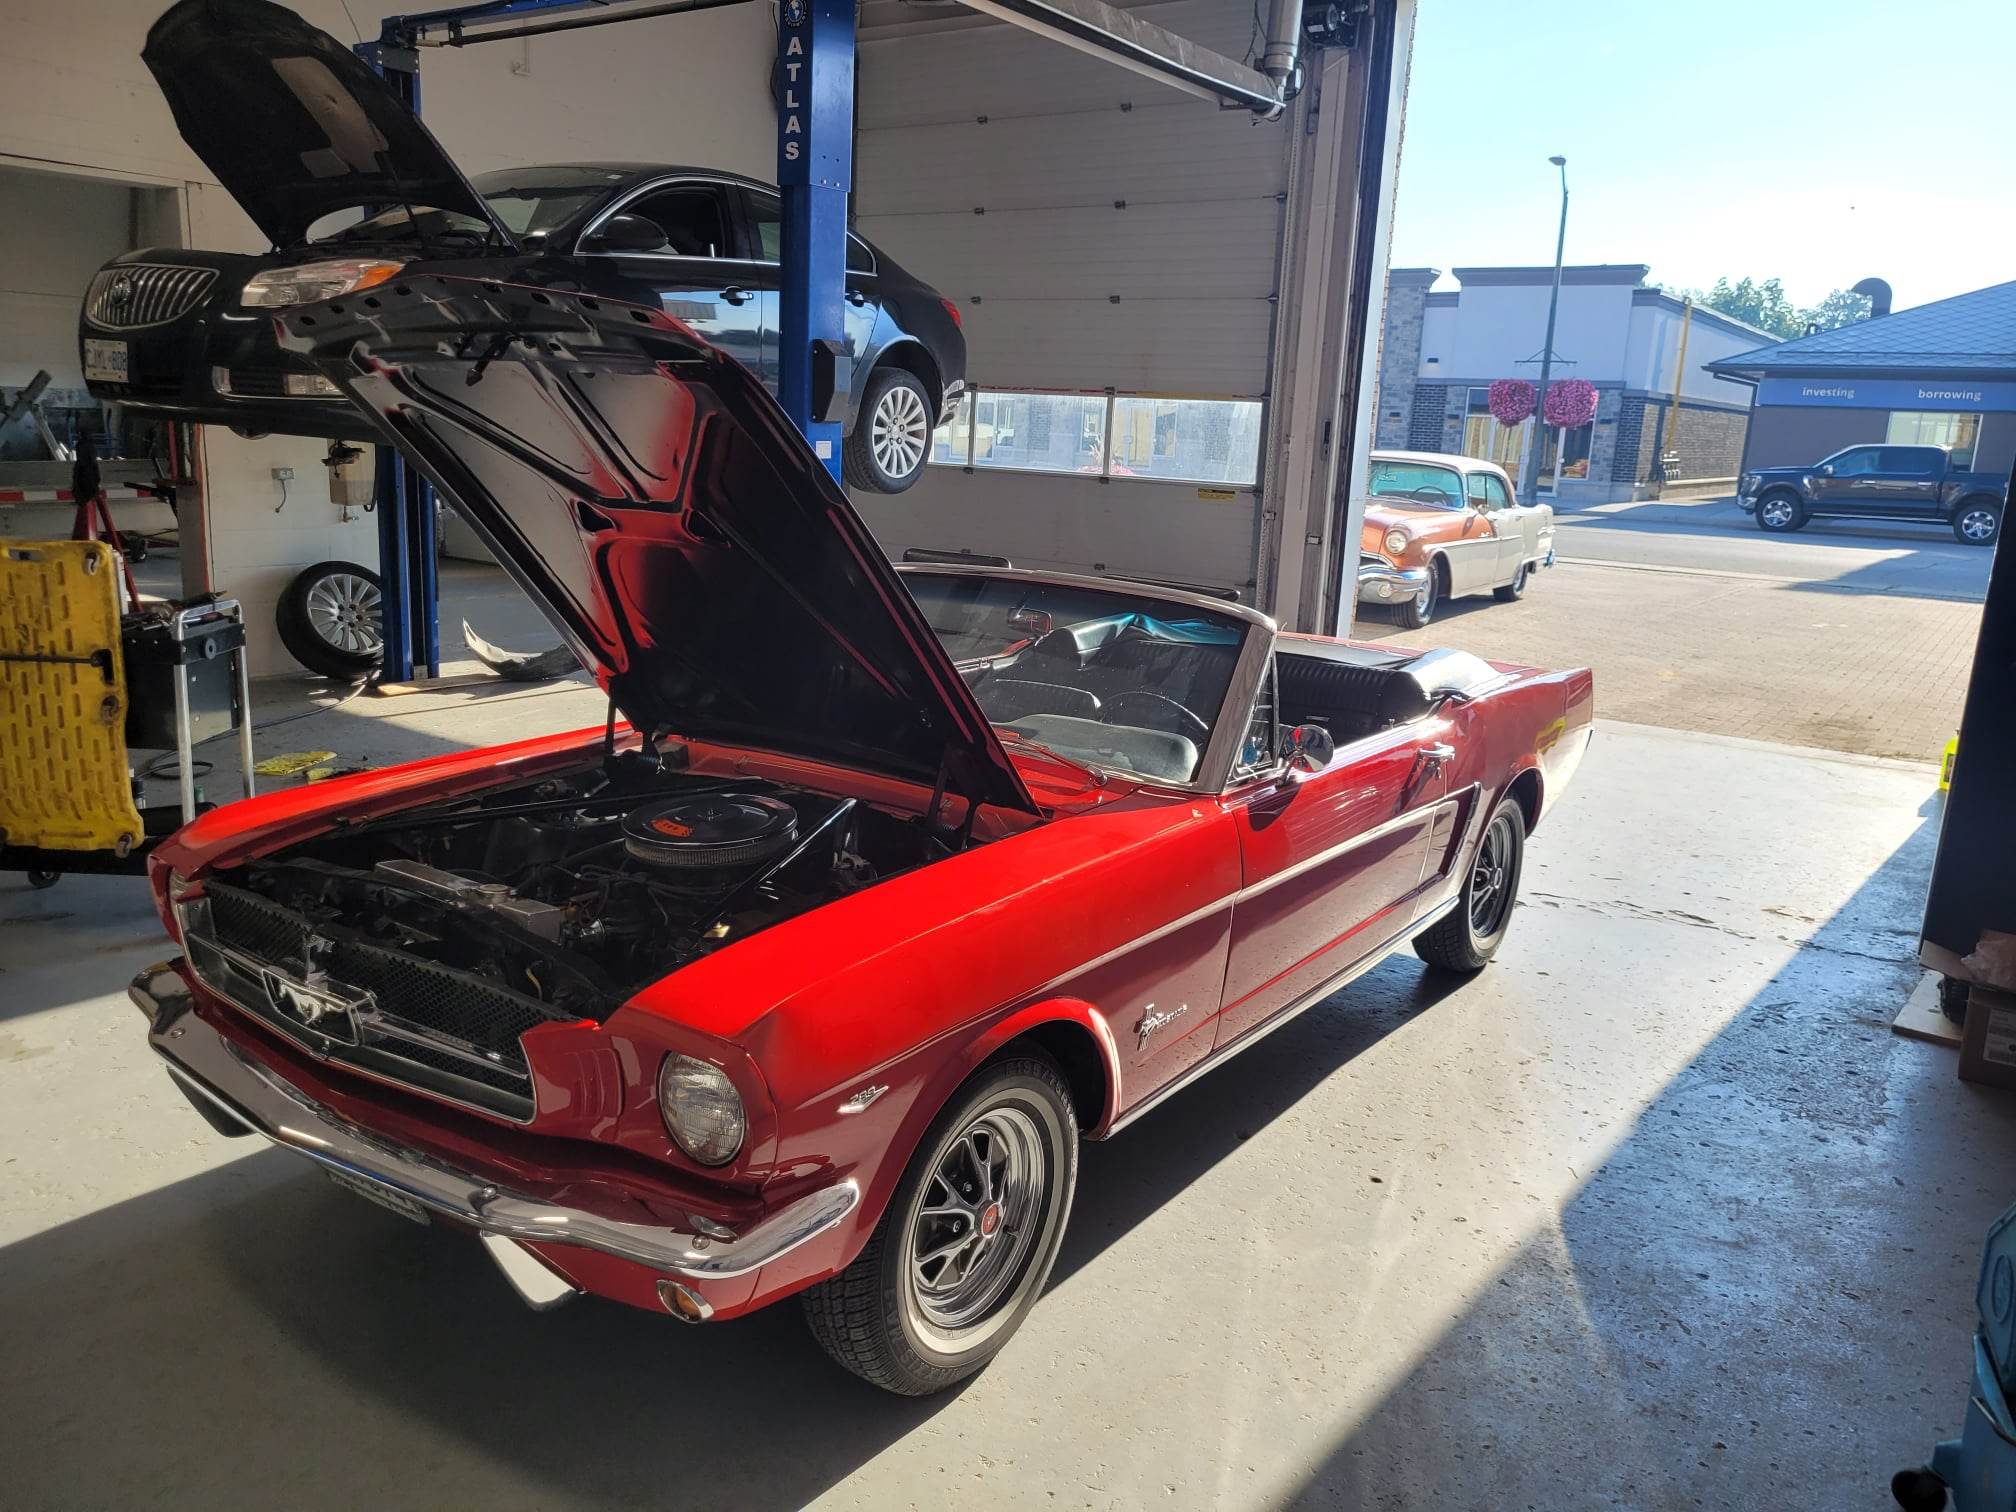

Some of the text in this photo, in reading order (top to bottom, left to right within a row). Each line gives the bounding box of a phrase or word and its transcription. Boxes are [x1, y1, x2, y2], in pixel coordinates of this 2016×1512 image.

[785, 36, 802, 160] ATLAS
[1802, 386, 1855, 399] investing
[1918, 388, 1981, 401] borrowing
